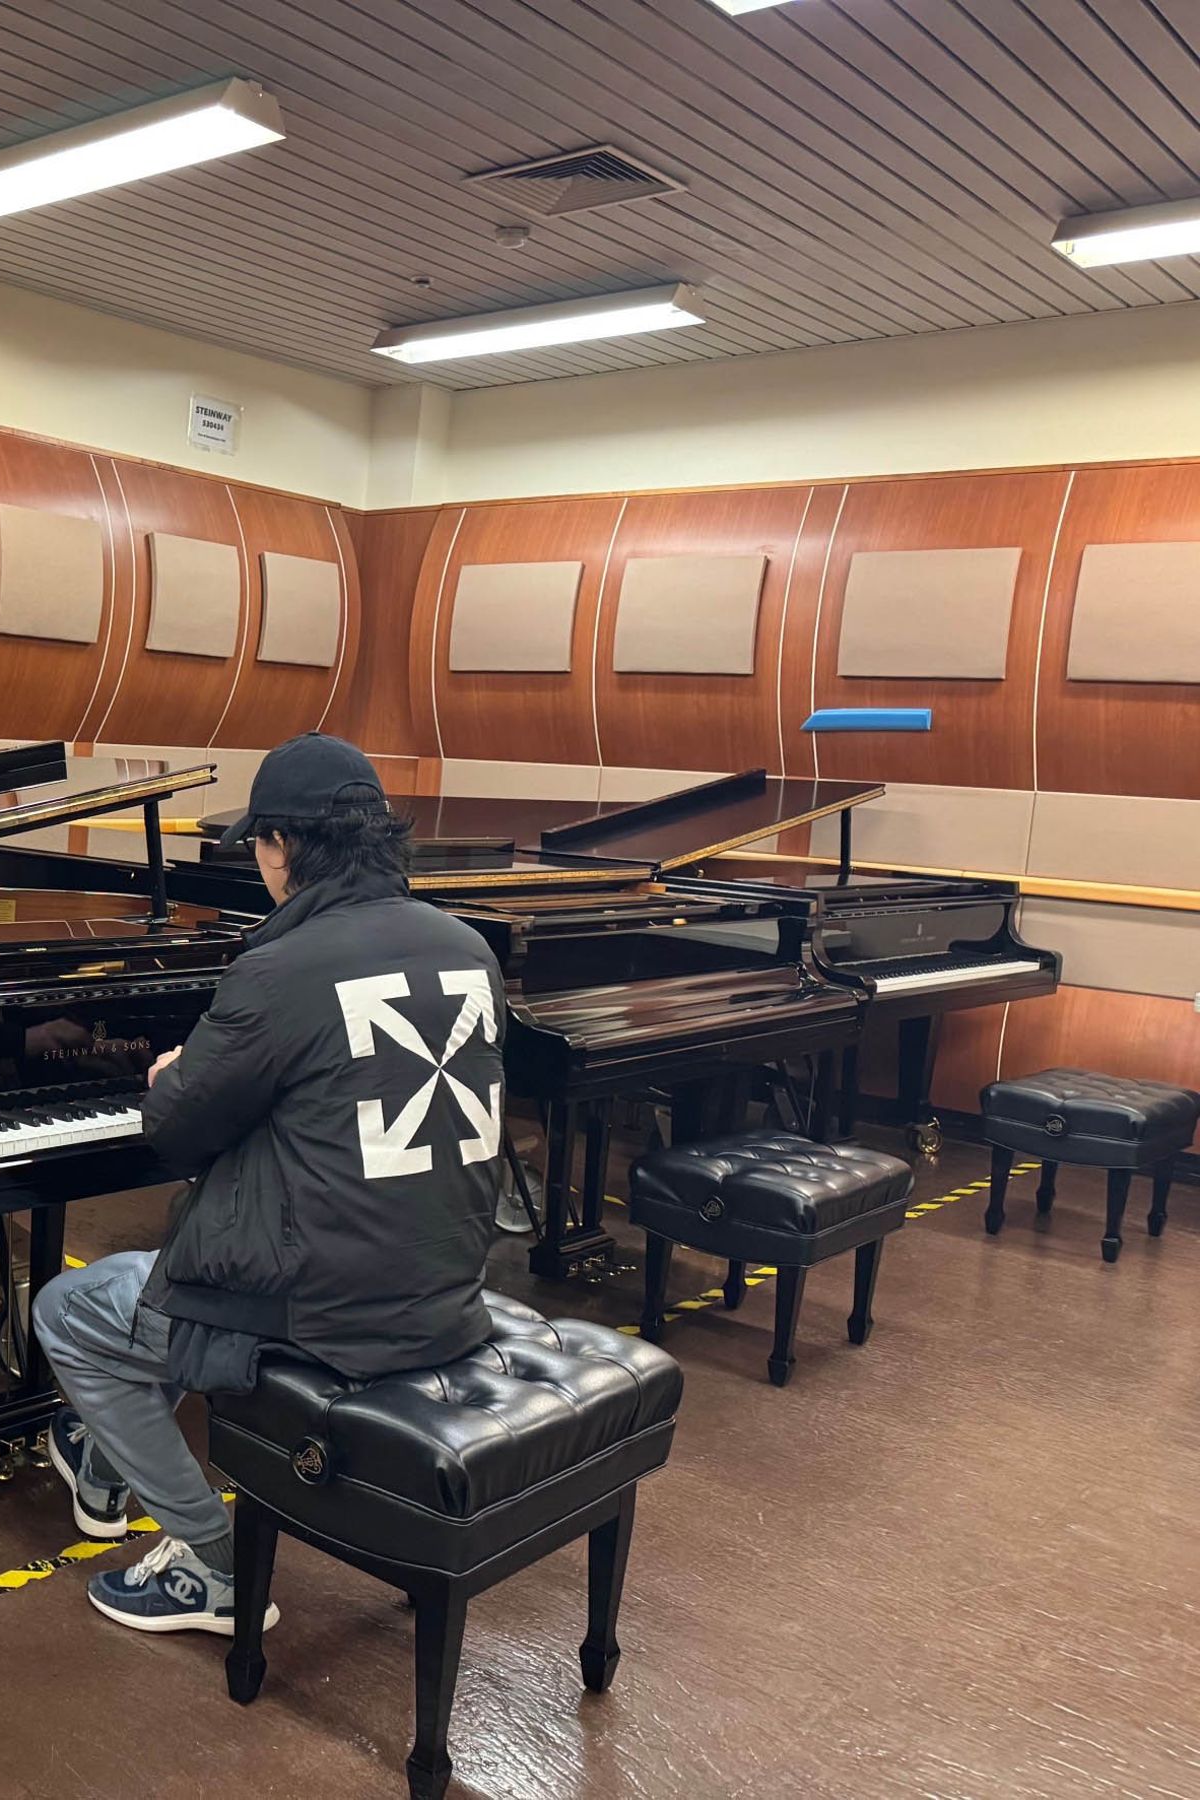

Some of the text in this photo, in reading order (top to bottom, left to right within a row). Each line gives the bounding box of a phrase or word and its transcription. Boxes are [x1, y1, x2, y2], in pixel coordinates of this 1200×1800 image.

[195, 405, 232, 422] STEINWAY
[43, 1040, 151, 1060] STEINWAY & SONS
